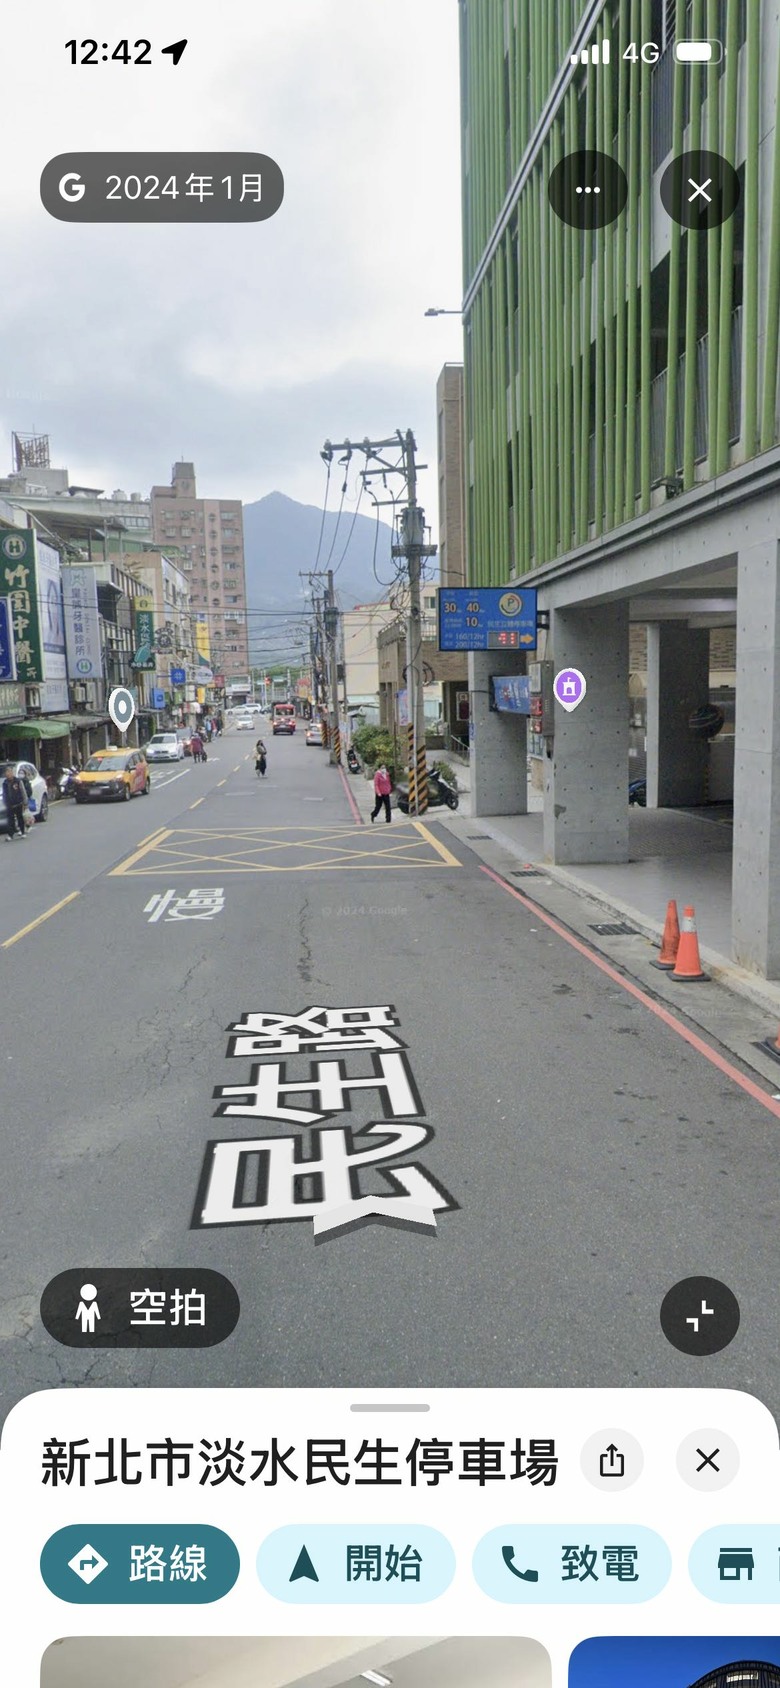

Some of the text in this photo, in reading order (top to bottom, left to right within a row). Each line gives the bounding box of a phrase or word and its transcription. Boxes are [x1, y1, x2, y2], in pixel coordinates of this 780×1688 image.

[444, 602, 457, 613] 30
[466, 602, 480, 613] 40
[466, 617, 478, 627] 10
[143, 887, 225, 923] 慢
